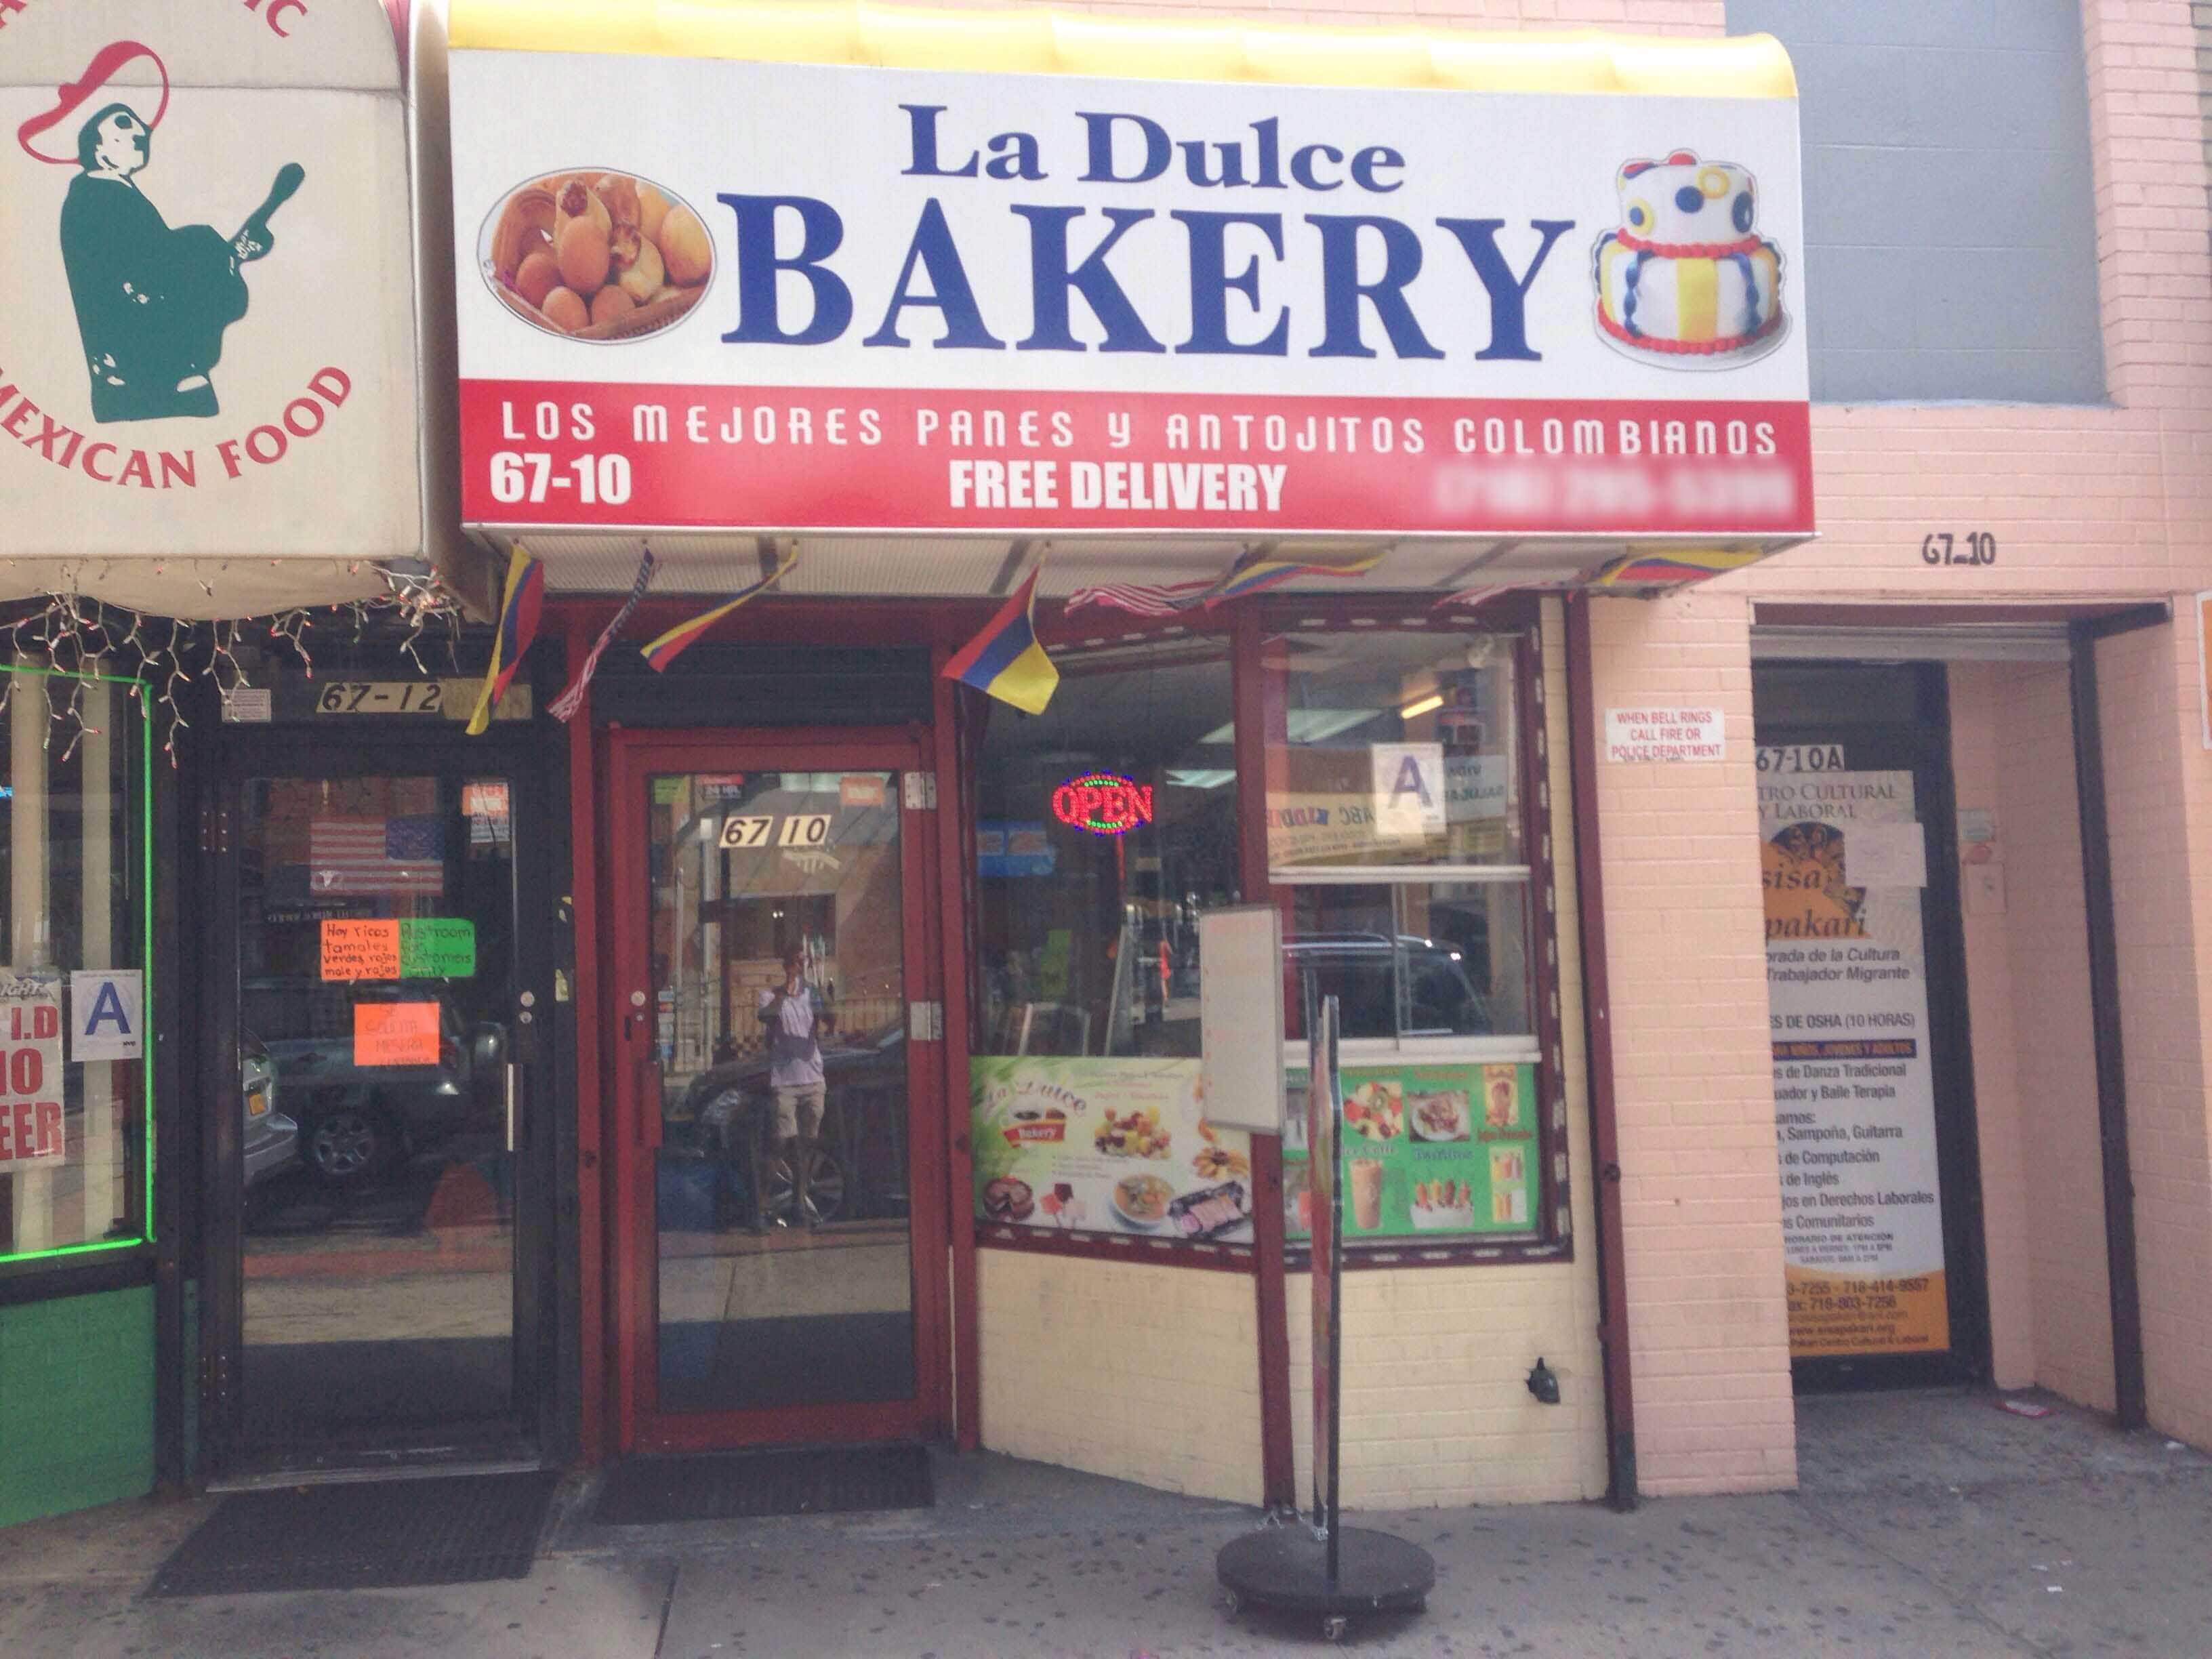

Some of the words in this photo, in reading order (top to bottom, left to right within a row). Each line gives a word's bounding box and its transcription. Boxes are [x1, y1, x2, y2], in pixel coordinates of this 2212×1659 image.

[899, 104, 1048, 181] La
[1076, 112, 1406, 192] Dulce
[717, 192, 1575, 361] BAKERY
[216, 366, 351, 478] FOOD
[503, 401, 595, 441] LOS
[634, 405, 882, 445] MEJORES
[918, 409, 1073, 447] PANES
[1166, 415, 1425, 453] ANTOJITOS
[1454, 418, 1777, 455] COLOMBIANOS
[490, 453, 631, 504] 67-10
[950, 460, 1058, 508] FREE
[1071, 462, 1287, 512] DELIVERY
[322, 684, 441, 710] 67-12
[1616, 712, 1648, 724] WHEN
[1652, 712, 1677, 724] BELL
[1681, 712, 1713, 724] RINGS
[1631, 728, 1657, 741] CALL
[1660, 728, 1683, 740] FIRE
[1686, 727, 1702, 740] OR
[1612, 745, 1650, 760] POLICE
[1652, 743, 1721, 758] DEPARTMENT
[1755, 747, 1841, 772] 67-10A
[1389, 754, 1433, 809] A
[1800, 782, 1896, 800] CULTURAL
[1052, 784, 1153, 825] OPEN
[1774, 802, 1856, 819] LABORAL
[725, 818, 771, 845] 67
[789, 817, 827, 844] 10
[1808, 948, 1827, 962] de
[1830, 947, 1843, 962] la
[1847, 947, 1900, 962] Cultura
[1846, 966, 1910, 982] Migrante
[85, 981, 131, 1036] A
[1786, 1015, 1803, 1029] DE
[1786, 1065, 1800, 1079] de
[1803, 1064, 1840, 1078] Danza
[1842, 1063, 1906, 1077] Tradicional
[1811, 1088, 1818, 1102] y
[1821, 1085, 1851, 1099] Baile
[1853, 1084, 1896, 1101] Terapia
[1852, 1124, 1903, 1139] Guitarra
[1784, 1152, 1800, 1165] de
[1786, 1173, 1801, 1186] de
[1802, 1196, 1817, 1208] en
[1819, 1192, 1875, 1206] Derechos
[1877, 1190, 1935, 1205] Laborales
[1796, 1213, 1875, 1229] Comunitarios
